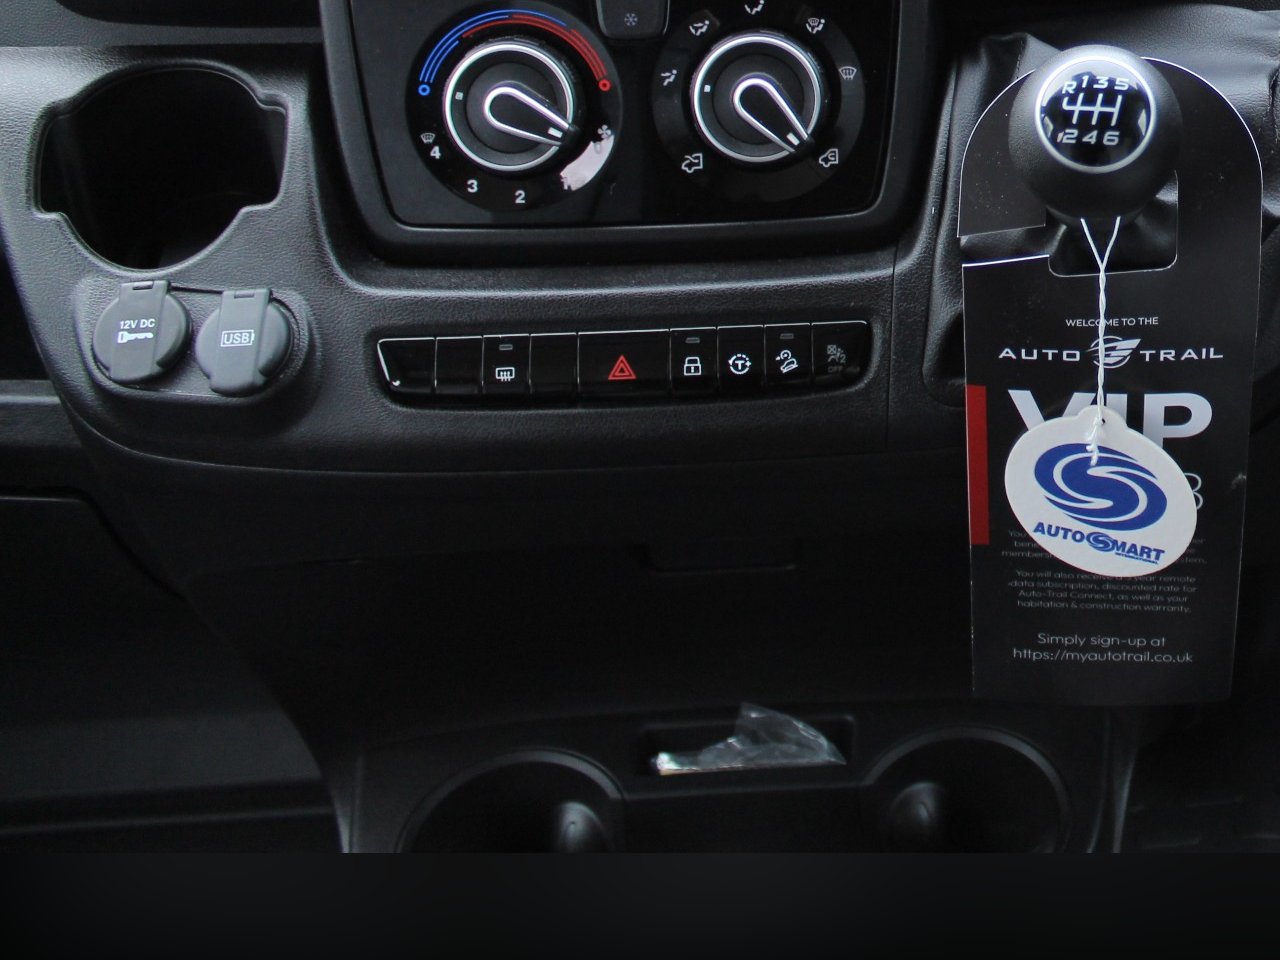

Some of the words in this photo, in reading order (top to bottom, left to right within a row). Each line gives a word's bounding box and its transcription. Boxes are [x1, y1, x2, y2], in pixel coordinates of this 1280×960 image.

[1062, 80, 1076, 94] R
[1081, 75, 1089, 88] 1
[1093, 76, 1109, 89] 3
[1114, 78, 1129, 90] 5
[1062, 129, 1077, 144] 2
[1082, 130, 1097, 144] 4
[1103, 131, 1120, 145] 6
[430, 145, 441, 160] 4
[467, 179, 478, 193] 3
[515, 190, 526, 204] 2
[119, 320, 139, 329] 12V
[140, 319, 155, 328] DC
[1121, 319, 1136, 327] TO
[1138, 317, 1159, 326] THE
[223, 332, 250, 344] USB
[999, 348, 1080, 361] AUTO
[1139, 347, 1224, 362] TRAIL
[1015, 569, 1034, 578] You
[1036, 569, 1052, 578] will
[1054, 571, 1075, 579] also
[1102, 582, 1157, 591] discounted
[1159, 583, 1180, 592] rate
[1017, 599, 1069, 609] habitation
[1070, 600, 1079, 609] &
[1079, 601, 1142, 611] construction
[1131, 593, 1151, 601] well
[1166, 595, 1189, 604] your
[1037, 632, 1086, 648] Simply
[1089, 635, 1147, 649] sign-up
[1150, 636, 1166, 647] at
[1013, 648, 1193, 664] https://myautotrail.co.uk
